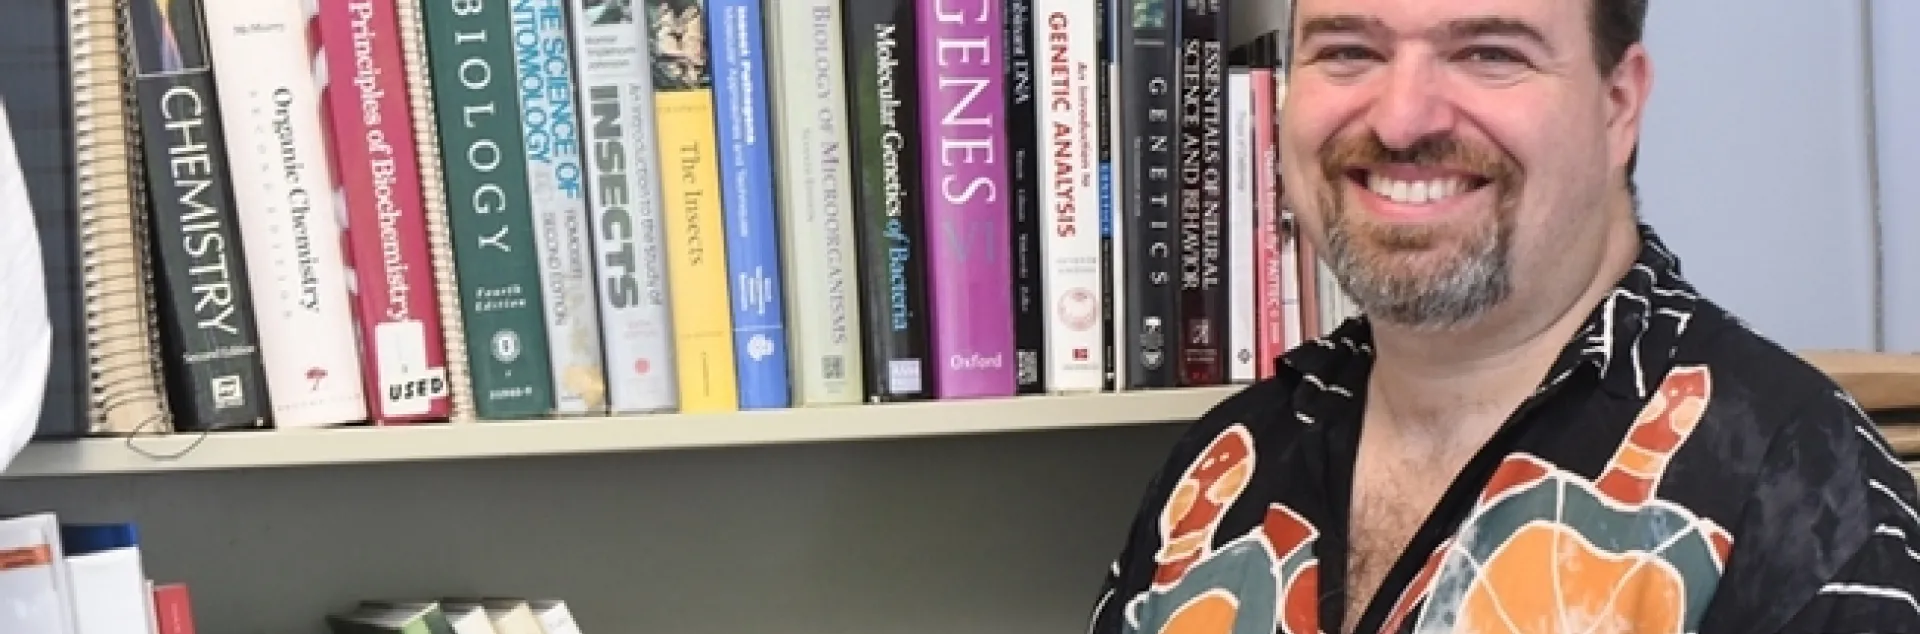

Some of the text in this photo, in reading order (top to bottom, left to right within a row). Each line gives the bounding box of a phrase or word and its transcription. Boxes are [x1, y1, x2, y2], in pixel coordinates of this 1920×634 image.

[542, 37, 577, 157] SCIENCE
[874, 23, 902, 128] Molecular
[1014, 61, 1030, 104] DNA
[1048, 11, 1072, 113] GENETIC
[347, 1, 411, 320] Principles of Biochemistry
[451, 0, 512, 252] BIOLOGY
[1181, 38, 1201, 290] SCIENCE AND BEHAVIOR
[1203, 40, 1221, 288] ESSENTIALS OF NEURAL
[160, 86, 237, 334] CHEMISTRY
[272, 87, 320, 312] Organic Chemistry
[554, 162, 583, 199] OF
[588, 85, 639, 309] INSECTS
[640, 200, 653, 216] to
[680, 141, 704, 267] The Insects
[812, 5, 848, 345] BIOLOGY OF MICROORGANISMS
[880, 128, 908, 217] Genetics
[1053, 121, 1077, 238] ANALYSIS
[1081, 173, 1091, 188] to
[1149, 77, 1168, 285] GENETICS
[641, 218, 659, 243] the
[643, 245, 661, 288] Study
[883, 218, 911, 244] of
[475, 284, 522, 299] Fourth
[475, 297, 527, 312] Edition
[548, 270, 569, 326] EDITION
[648, 289, 663, 306] of
[888, 247, 914, 332] Bacteria
[388, 376, 444, 402] USED
[949, 351, 1003, 371] Oxford
